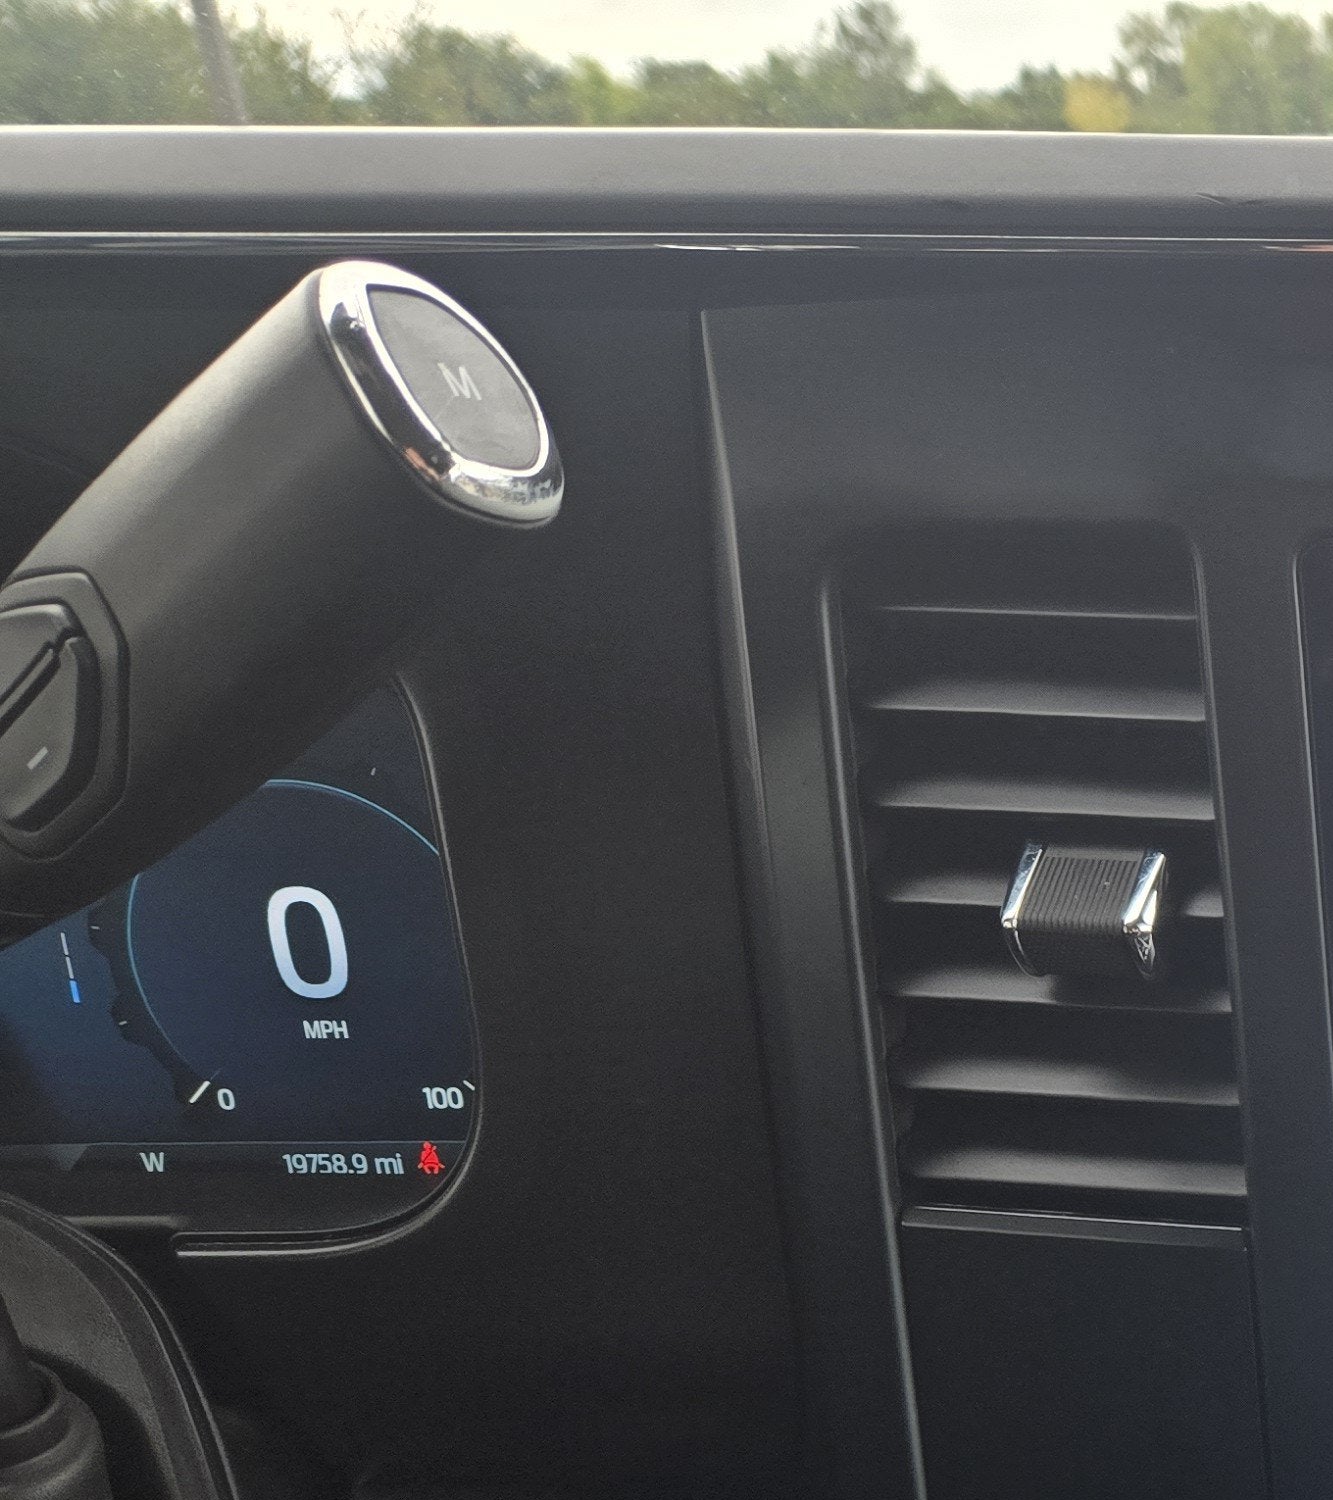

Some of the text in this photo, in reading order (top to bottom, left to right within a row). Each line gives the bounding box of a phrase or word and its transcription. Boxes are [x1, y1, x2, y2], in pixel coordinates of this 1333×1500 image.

[437, 362, 482, 401] M
[267, 886, 348, 999] 0
[302, 1020, 349, 1040] MPH
[217, 1088, 236, 1111] 0
[422, 1086, 464, 1110] 100
[139, 1152, 165, 1173] W
[282, 1152, 404, 1175] 19758.9 mi
